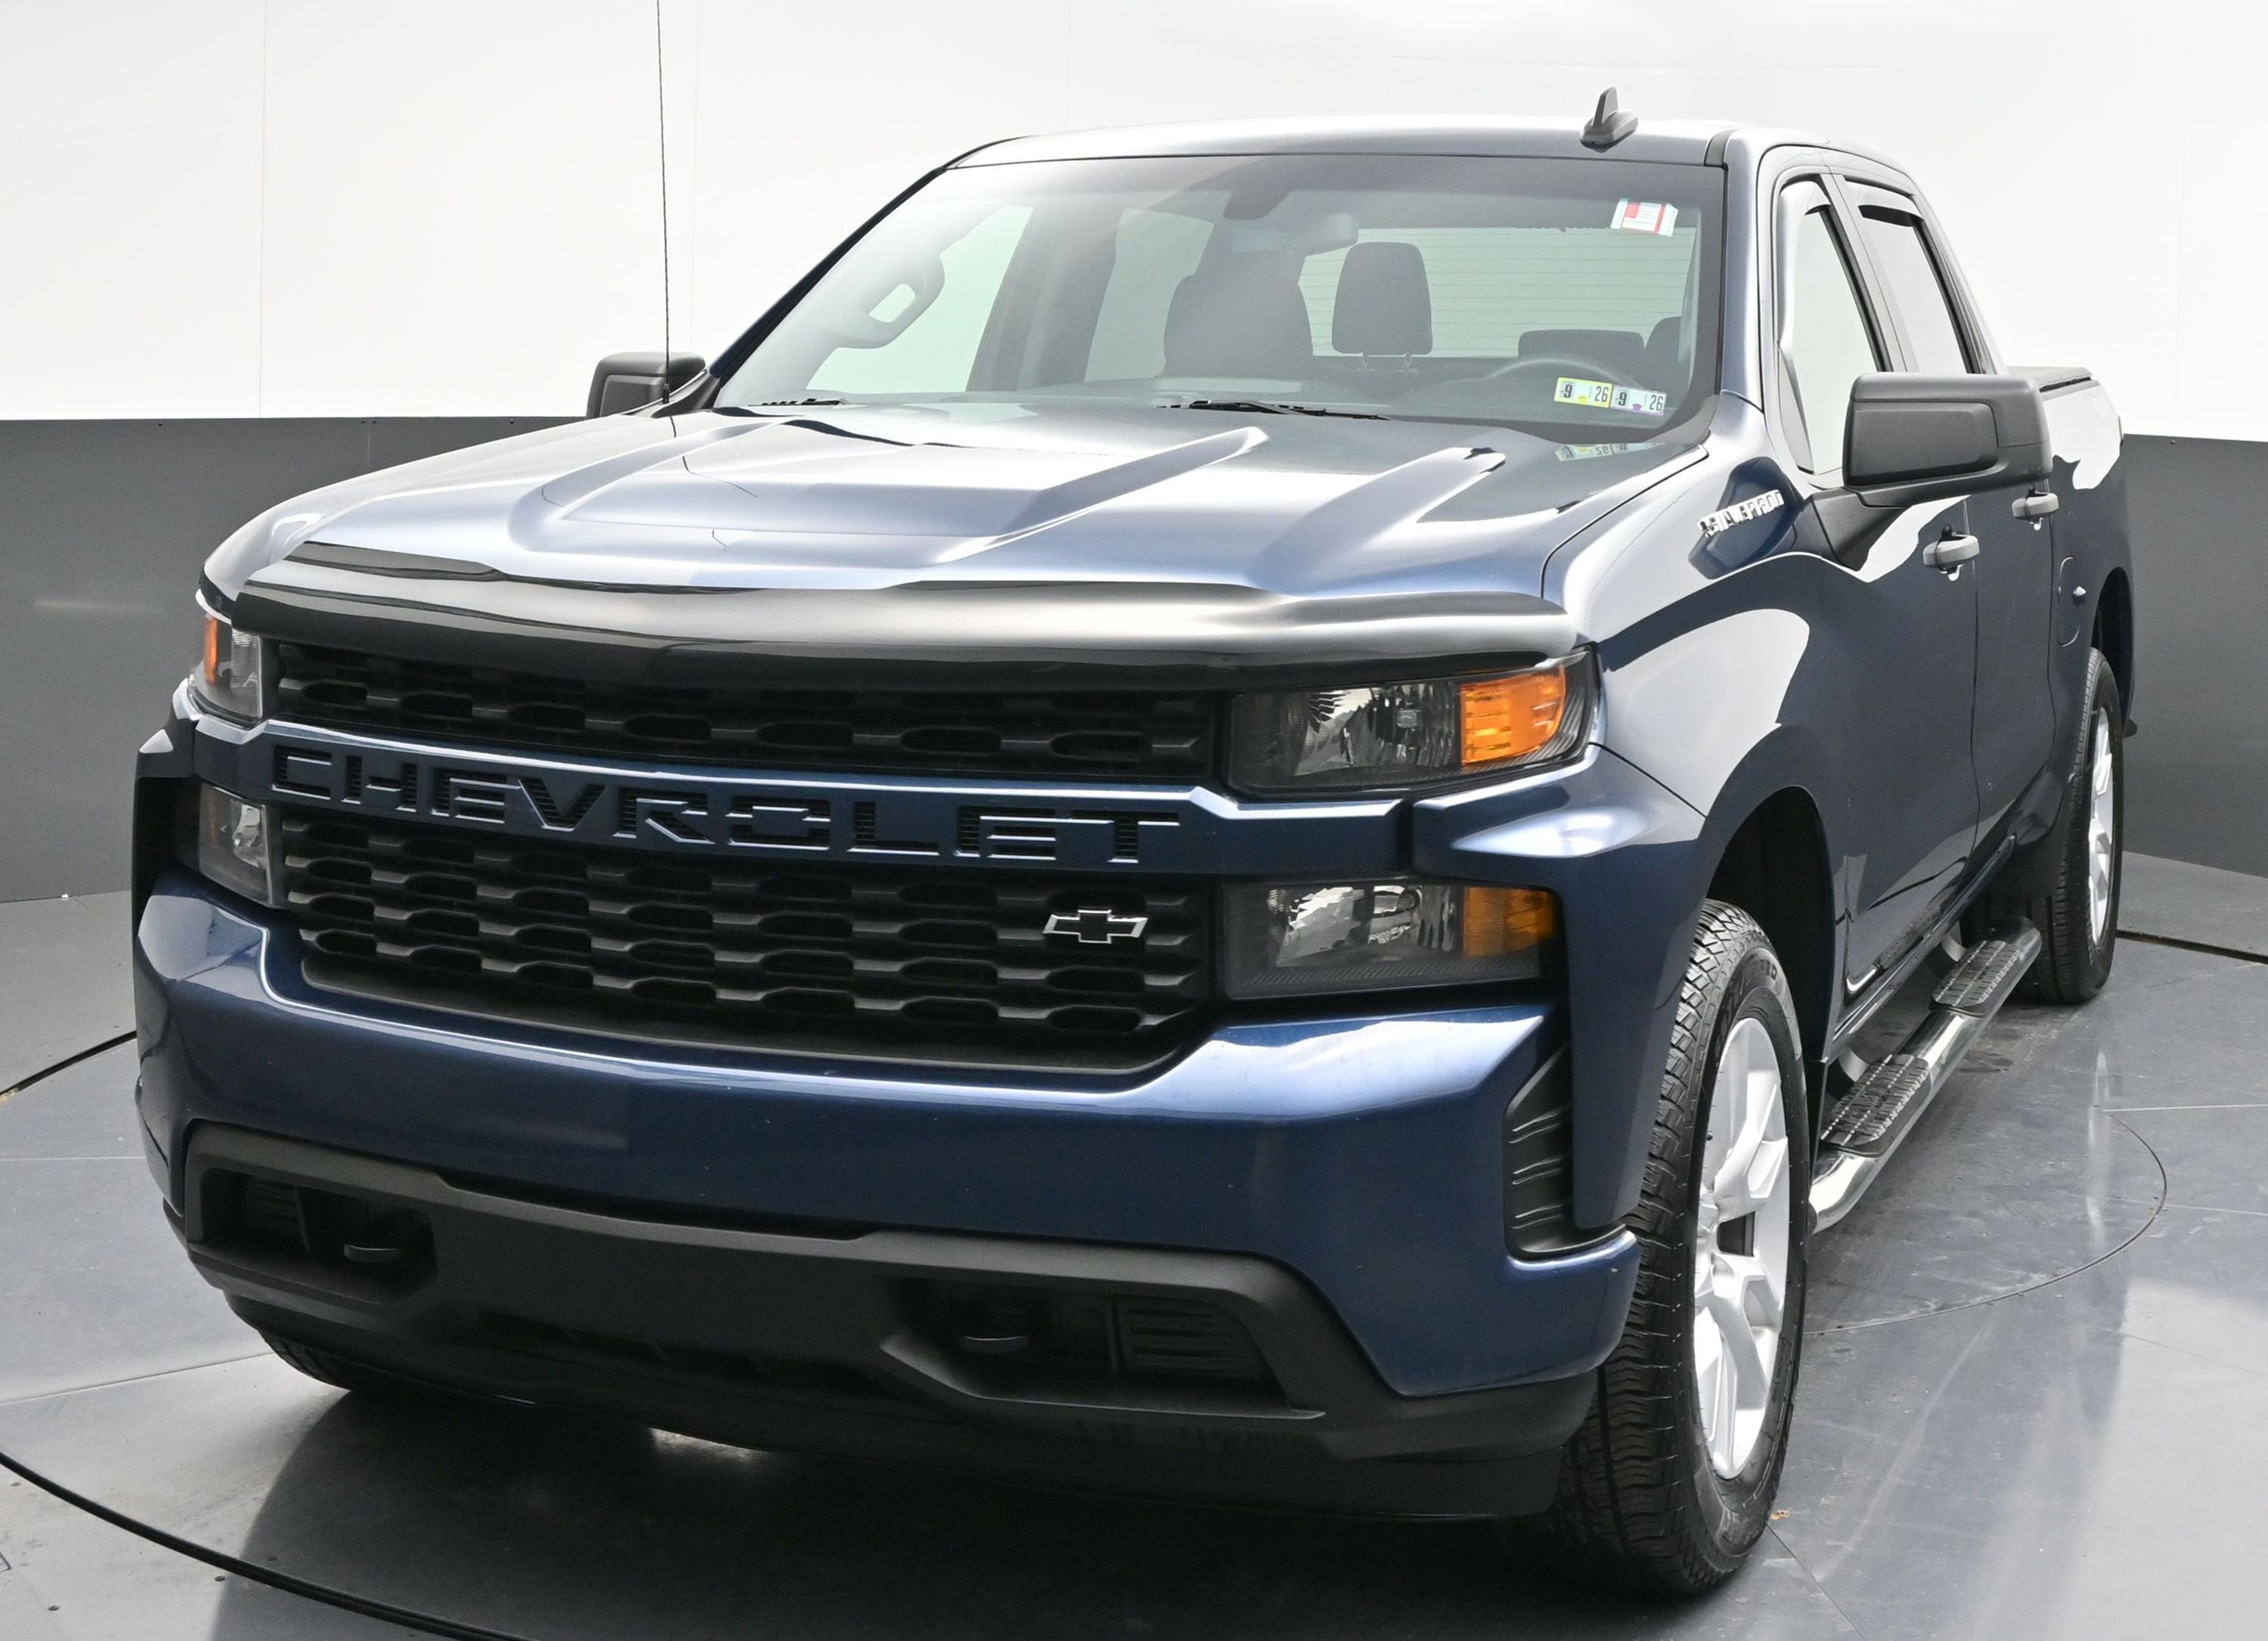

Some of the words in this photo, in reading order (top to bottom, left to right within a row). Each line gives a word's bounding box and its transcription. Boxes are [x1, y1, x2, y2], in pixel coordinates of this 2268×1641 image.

[1563, 383, 1573, 399] 9
[1594, 386, 1610, 402] 26
[1618, 392, 1628, 407] 9
[1649, 394, 1664, 411] 26
[1697, 489, 1785, 538] SILVERADO
[271, 744, 1180, 864] CHEVROLET
